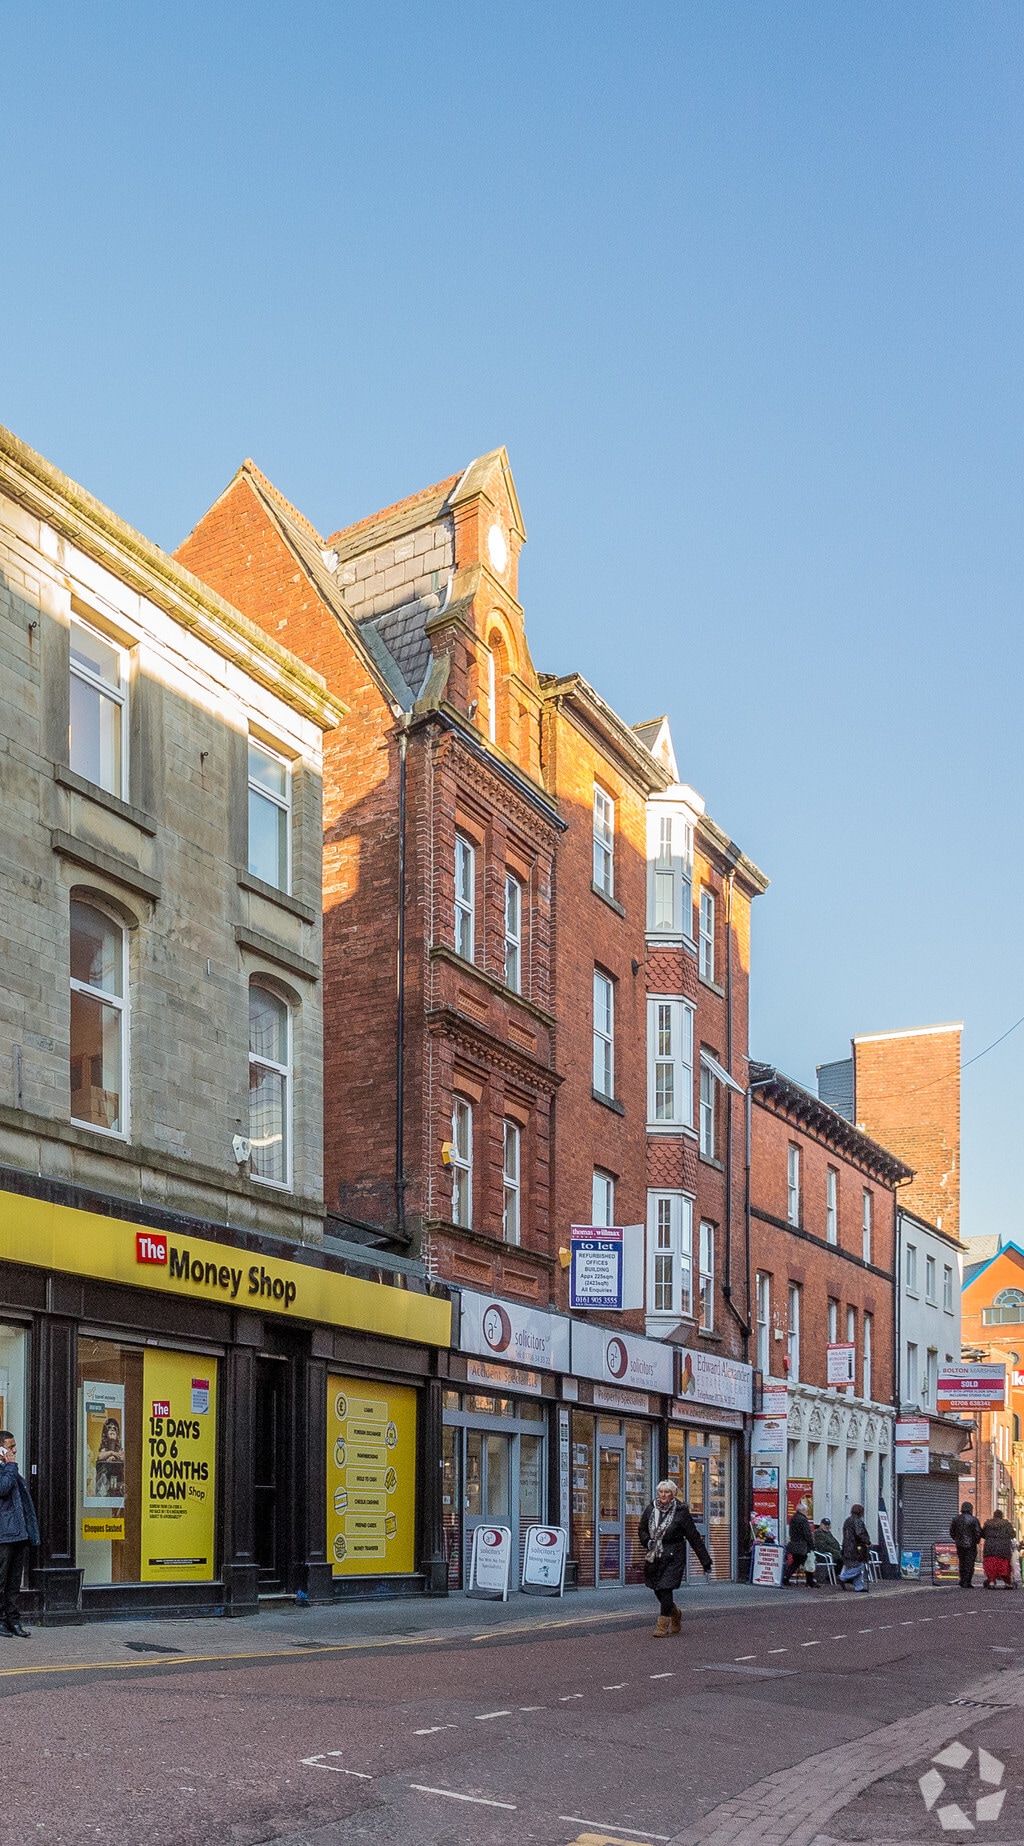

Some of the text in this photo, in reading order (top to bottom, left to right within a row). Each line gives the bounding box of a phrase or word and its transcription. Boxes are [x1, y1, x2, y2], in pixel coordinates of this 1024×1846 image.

[581, 1242, 614, 1250] to let
[138, 1238, 297, 1308] The Money Shop
[515, 1329, 546, 1352] solicitors
[471, 1365, 538, 1388] Accident Specialists
[630, 1358, 654, 1376] solicitors
[697, 1354, 750, 1383] Edward Alexander
[960, 1380, 979, 1388] SOLD
[153, 1403, 169, 1415] The
[149, 1416, 200, 1440] 15 DAYS
[148, 1438, 178, 1459] TO 6
[149, 1459, 209, 1481] MONTHS
[149, 1480, 206, 1501] LOAN Shop
[84, 1524, 122, 1534] Cheques Cashed
